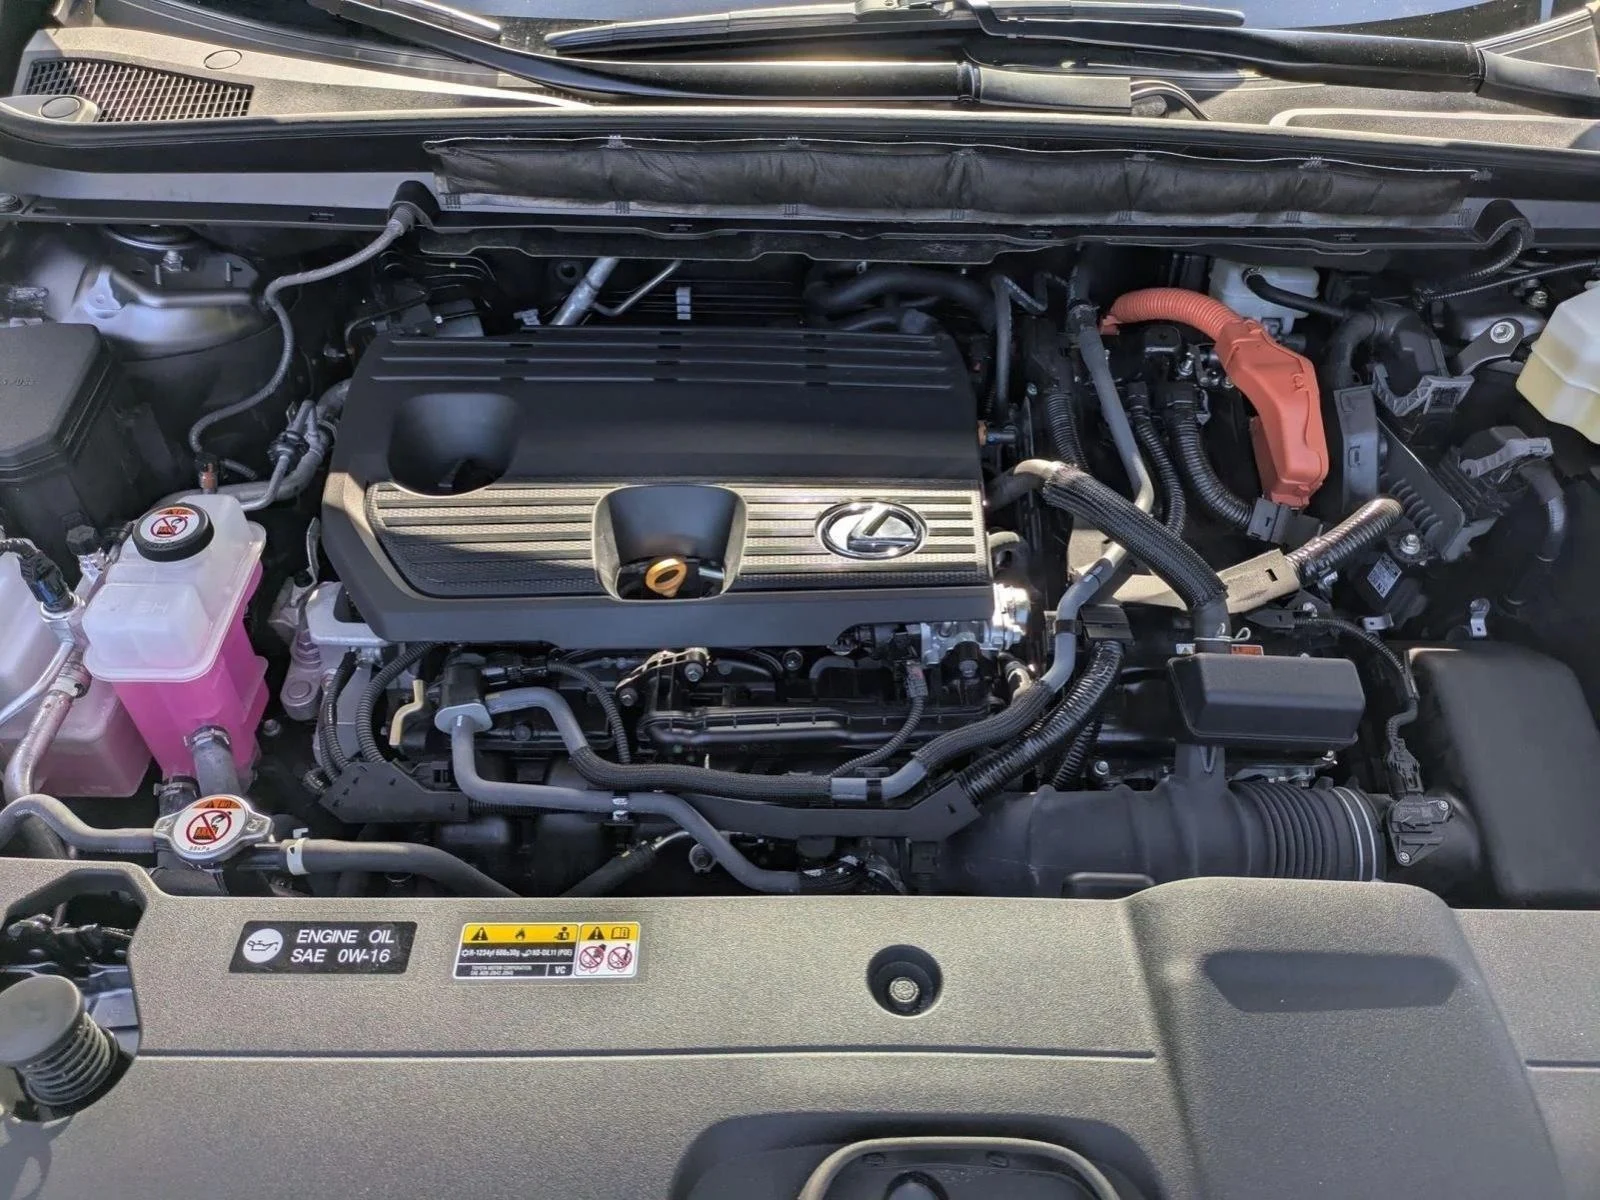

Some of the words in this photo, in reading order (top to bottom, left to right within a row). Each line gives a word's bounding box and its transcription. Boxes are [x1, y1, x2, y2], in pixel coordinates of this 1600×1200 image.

[296, 929, 359, 944] ENGINE
[368, 929, 395, 944] OIL
[290, 948, 327, 963] SAE
[337, 948, 391, 963] 0W-16
[554, 965, 567, 974] VC
